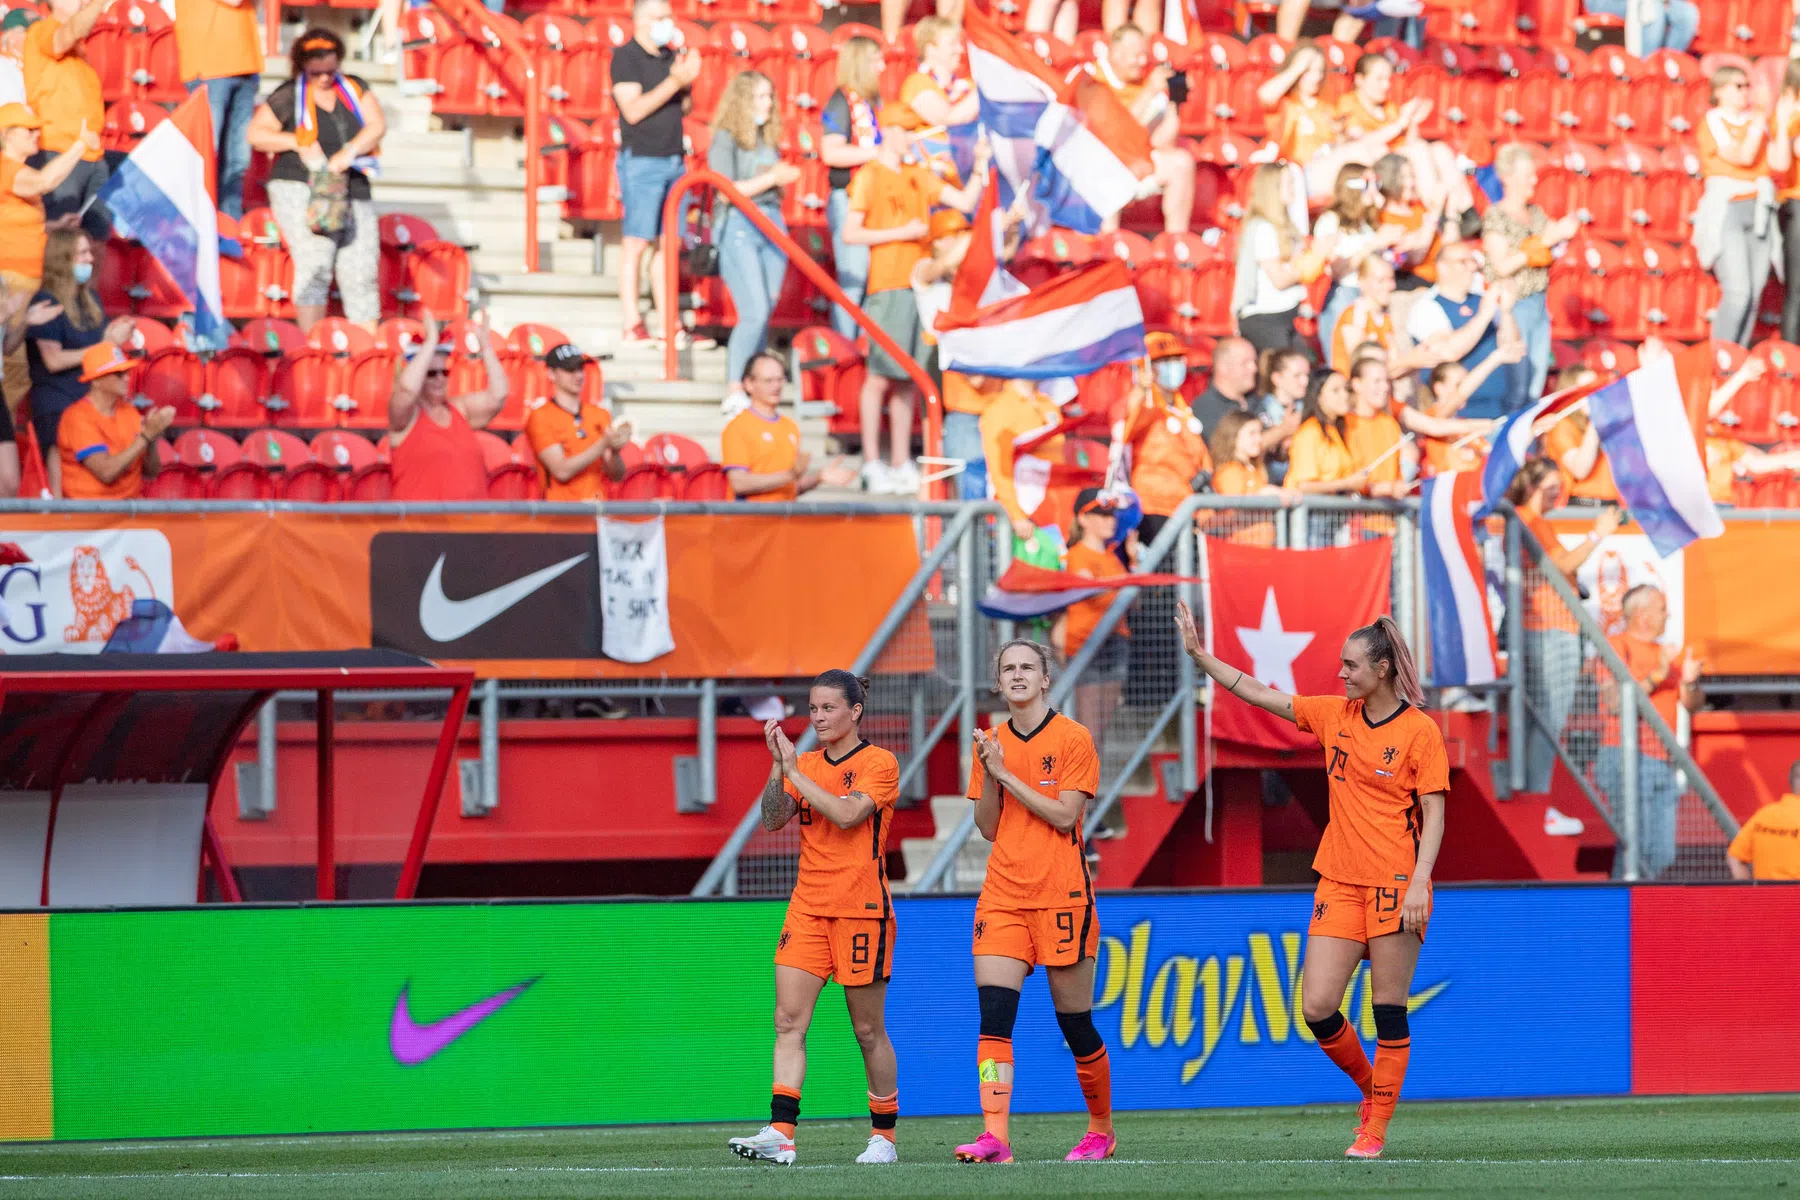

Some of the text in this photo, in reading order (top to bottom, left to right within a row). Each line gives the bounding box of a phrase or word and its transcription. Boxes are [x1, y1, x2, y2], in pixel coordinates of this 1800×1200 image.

[1327, 745, 1349, 782] 19
[1375, 887, 1399, 913] 19
[1056, 912, 1074, 944] 9
[852, 933, 869, 964] 8
